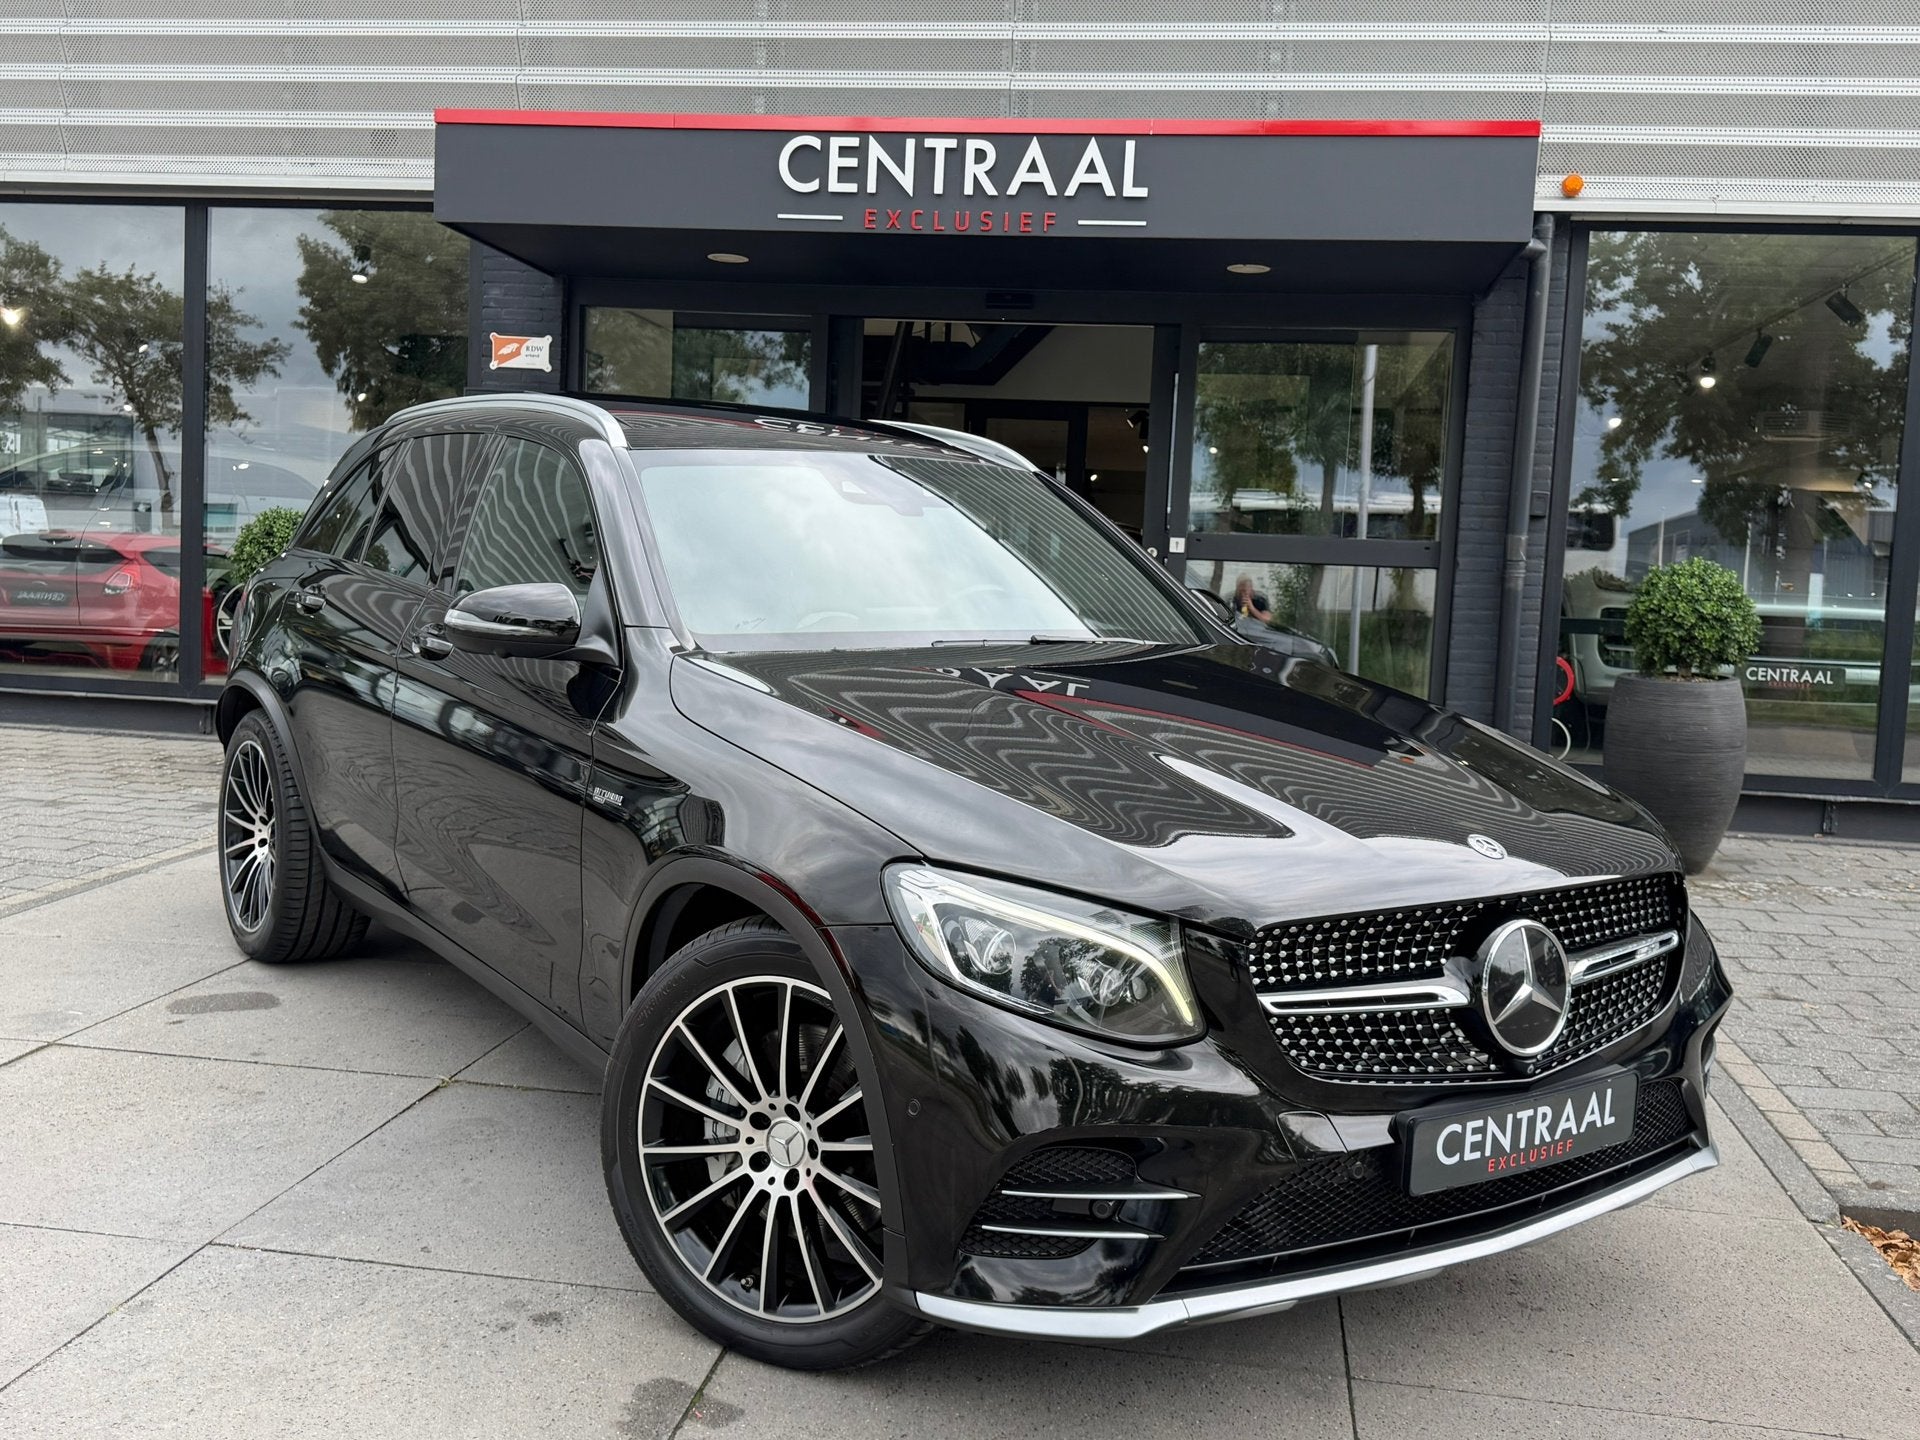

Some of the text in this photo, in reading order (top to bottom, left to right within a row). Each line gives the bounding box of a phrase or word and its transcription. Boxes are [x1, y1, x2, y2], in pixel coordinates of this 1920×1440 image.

[777, 134, 1149, 198] CENTRAAL
[863, 208, 1058, 233] EXCLUSIEF
[1746, 667, 1834, 685] CENTRAAL
[1436, 1088, 1616, 1166] CENTRAAL
[1488, 1139, 1574, 1172] EXCLUSIEF
